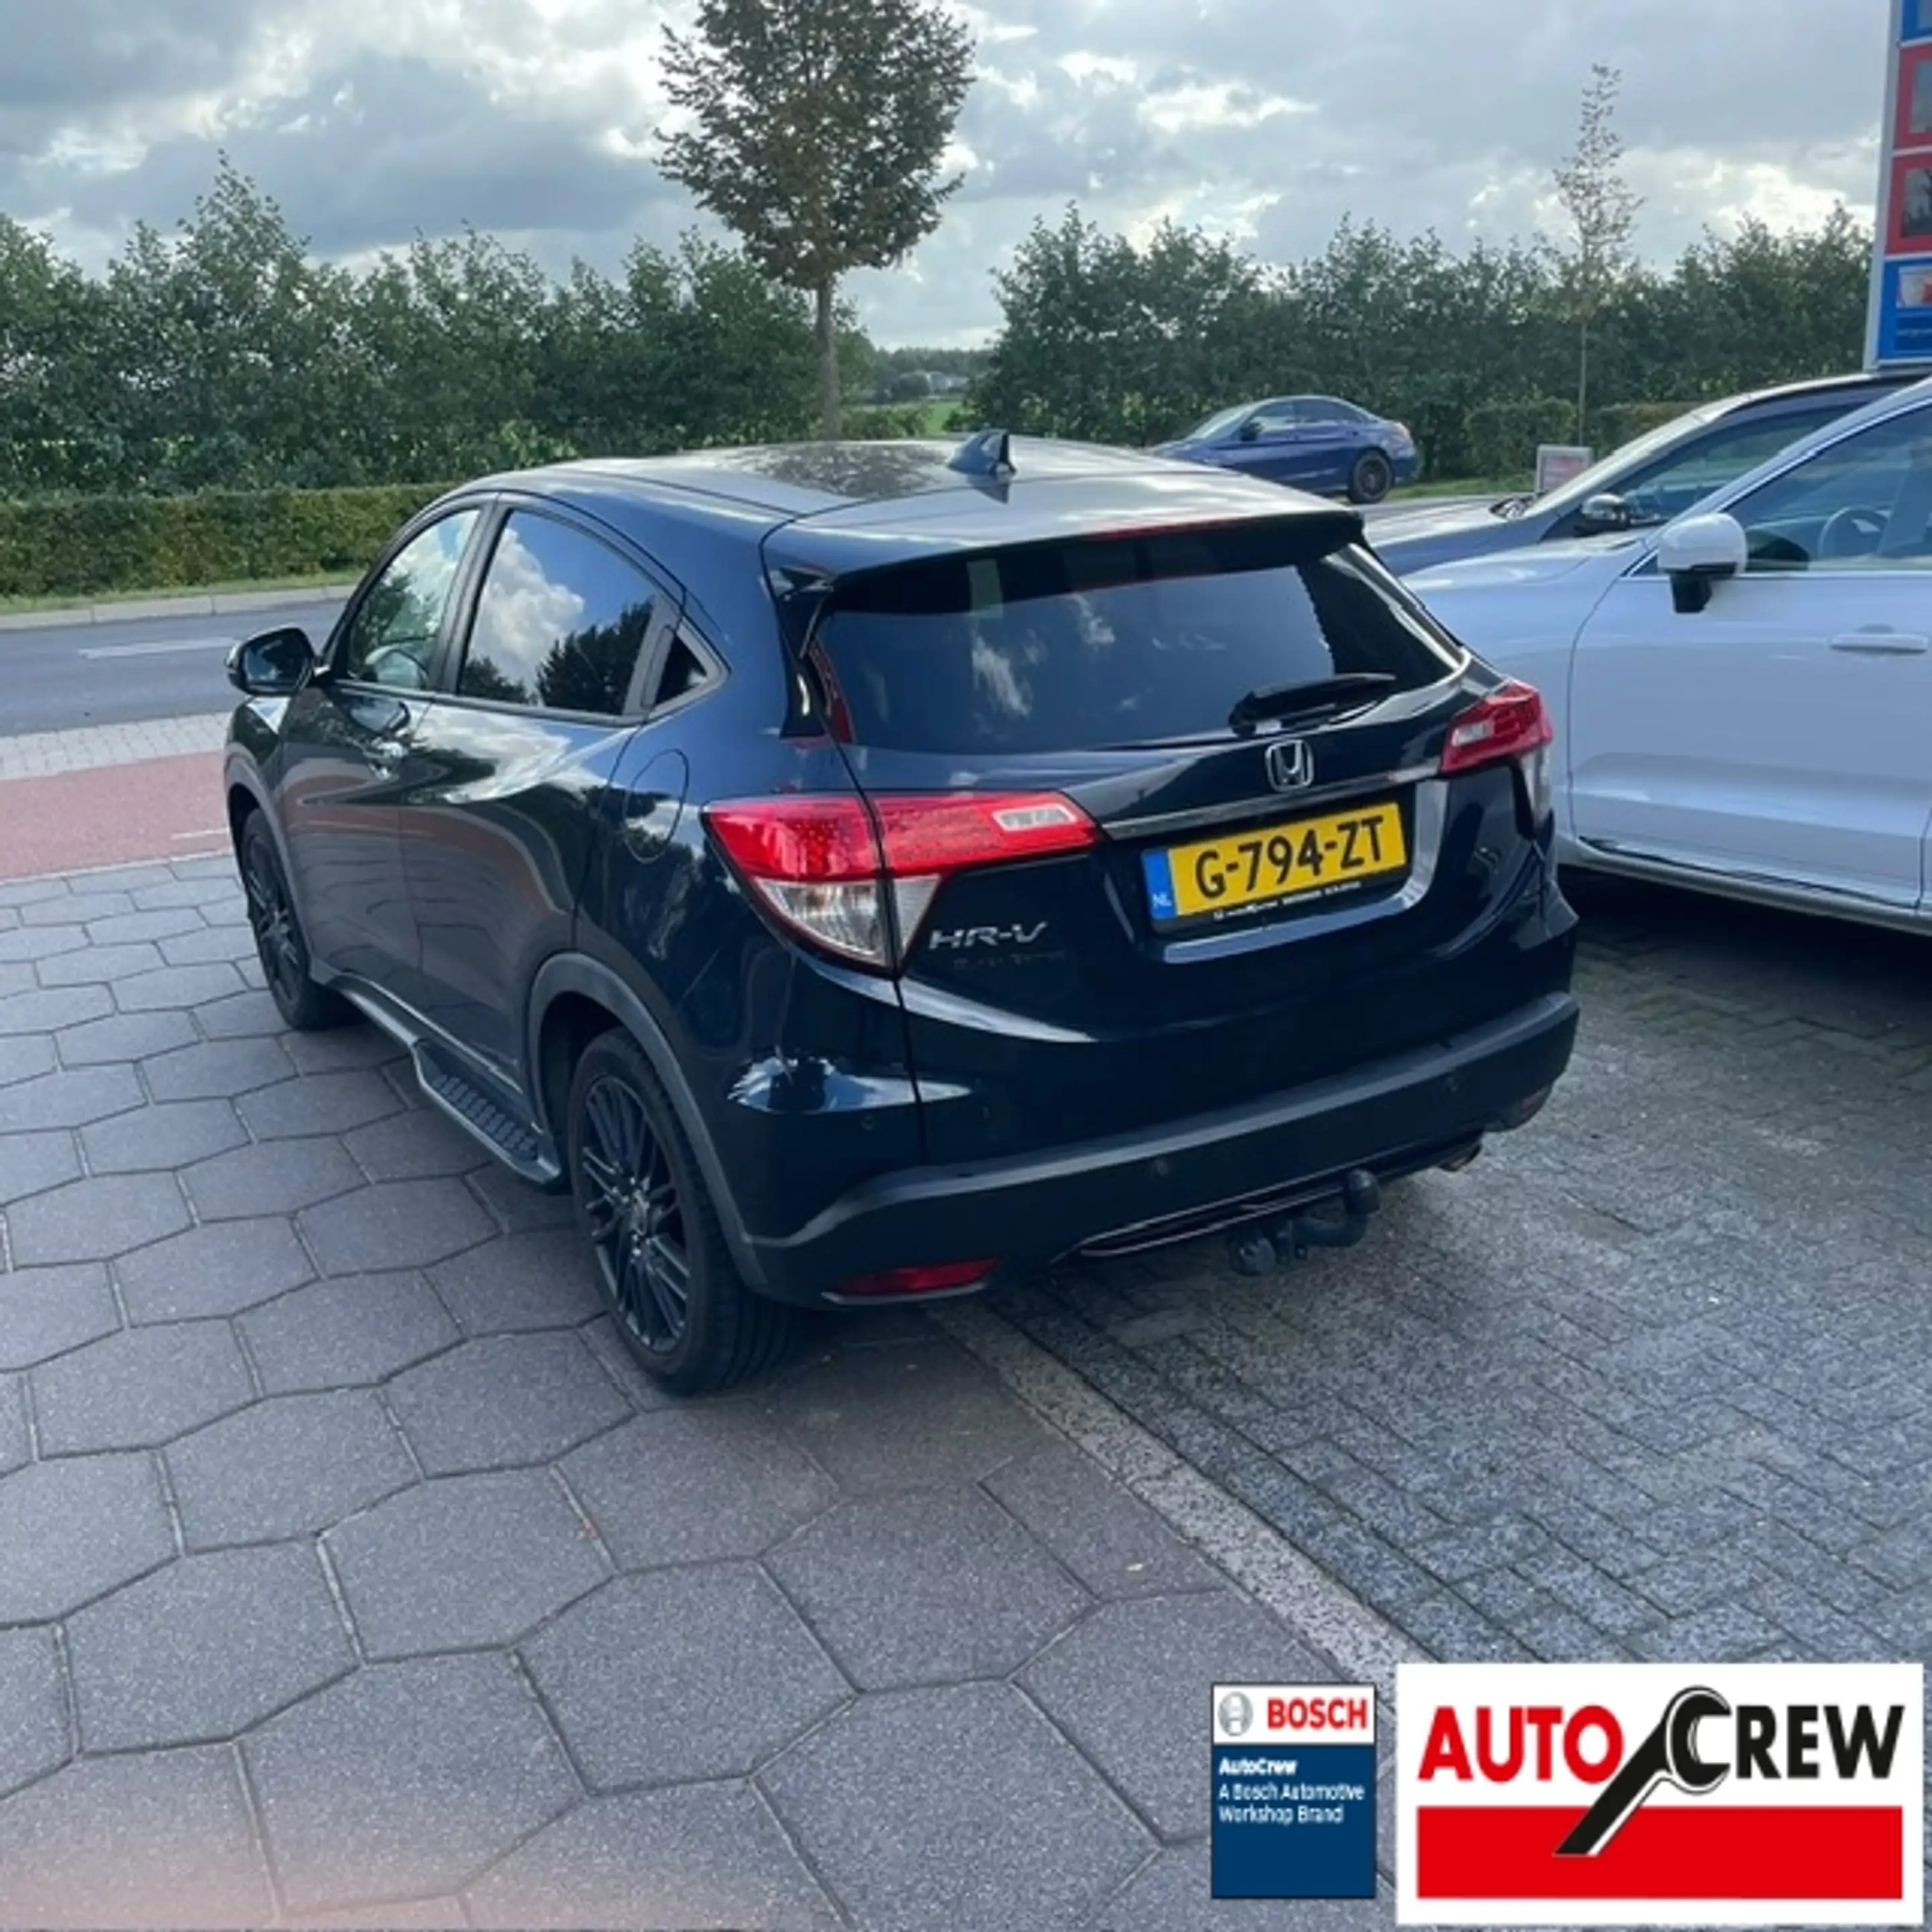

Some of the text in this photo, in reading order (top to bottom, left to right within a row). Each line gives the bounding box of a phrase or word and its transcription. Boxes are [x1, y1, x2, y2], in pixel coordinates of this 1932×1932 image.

[1195, 815, 1384, 900] G-794-ZT
[1152, 892, 1172, 908] NL
[928, 920, 1048, 950] HR-V
